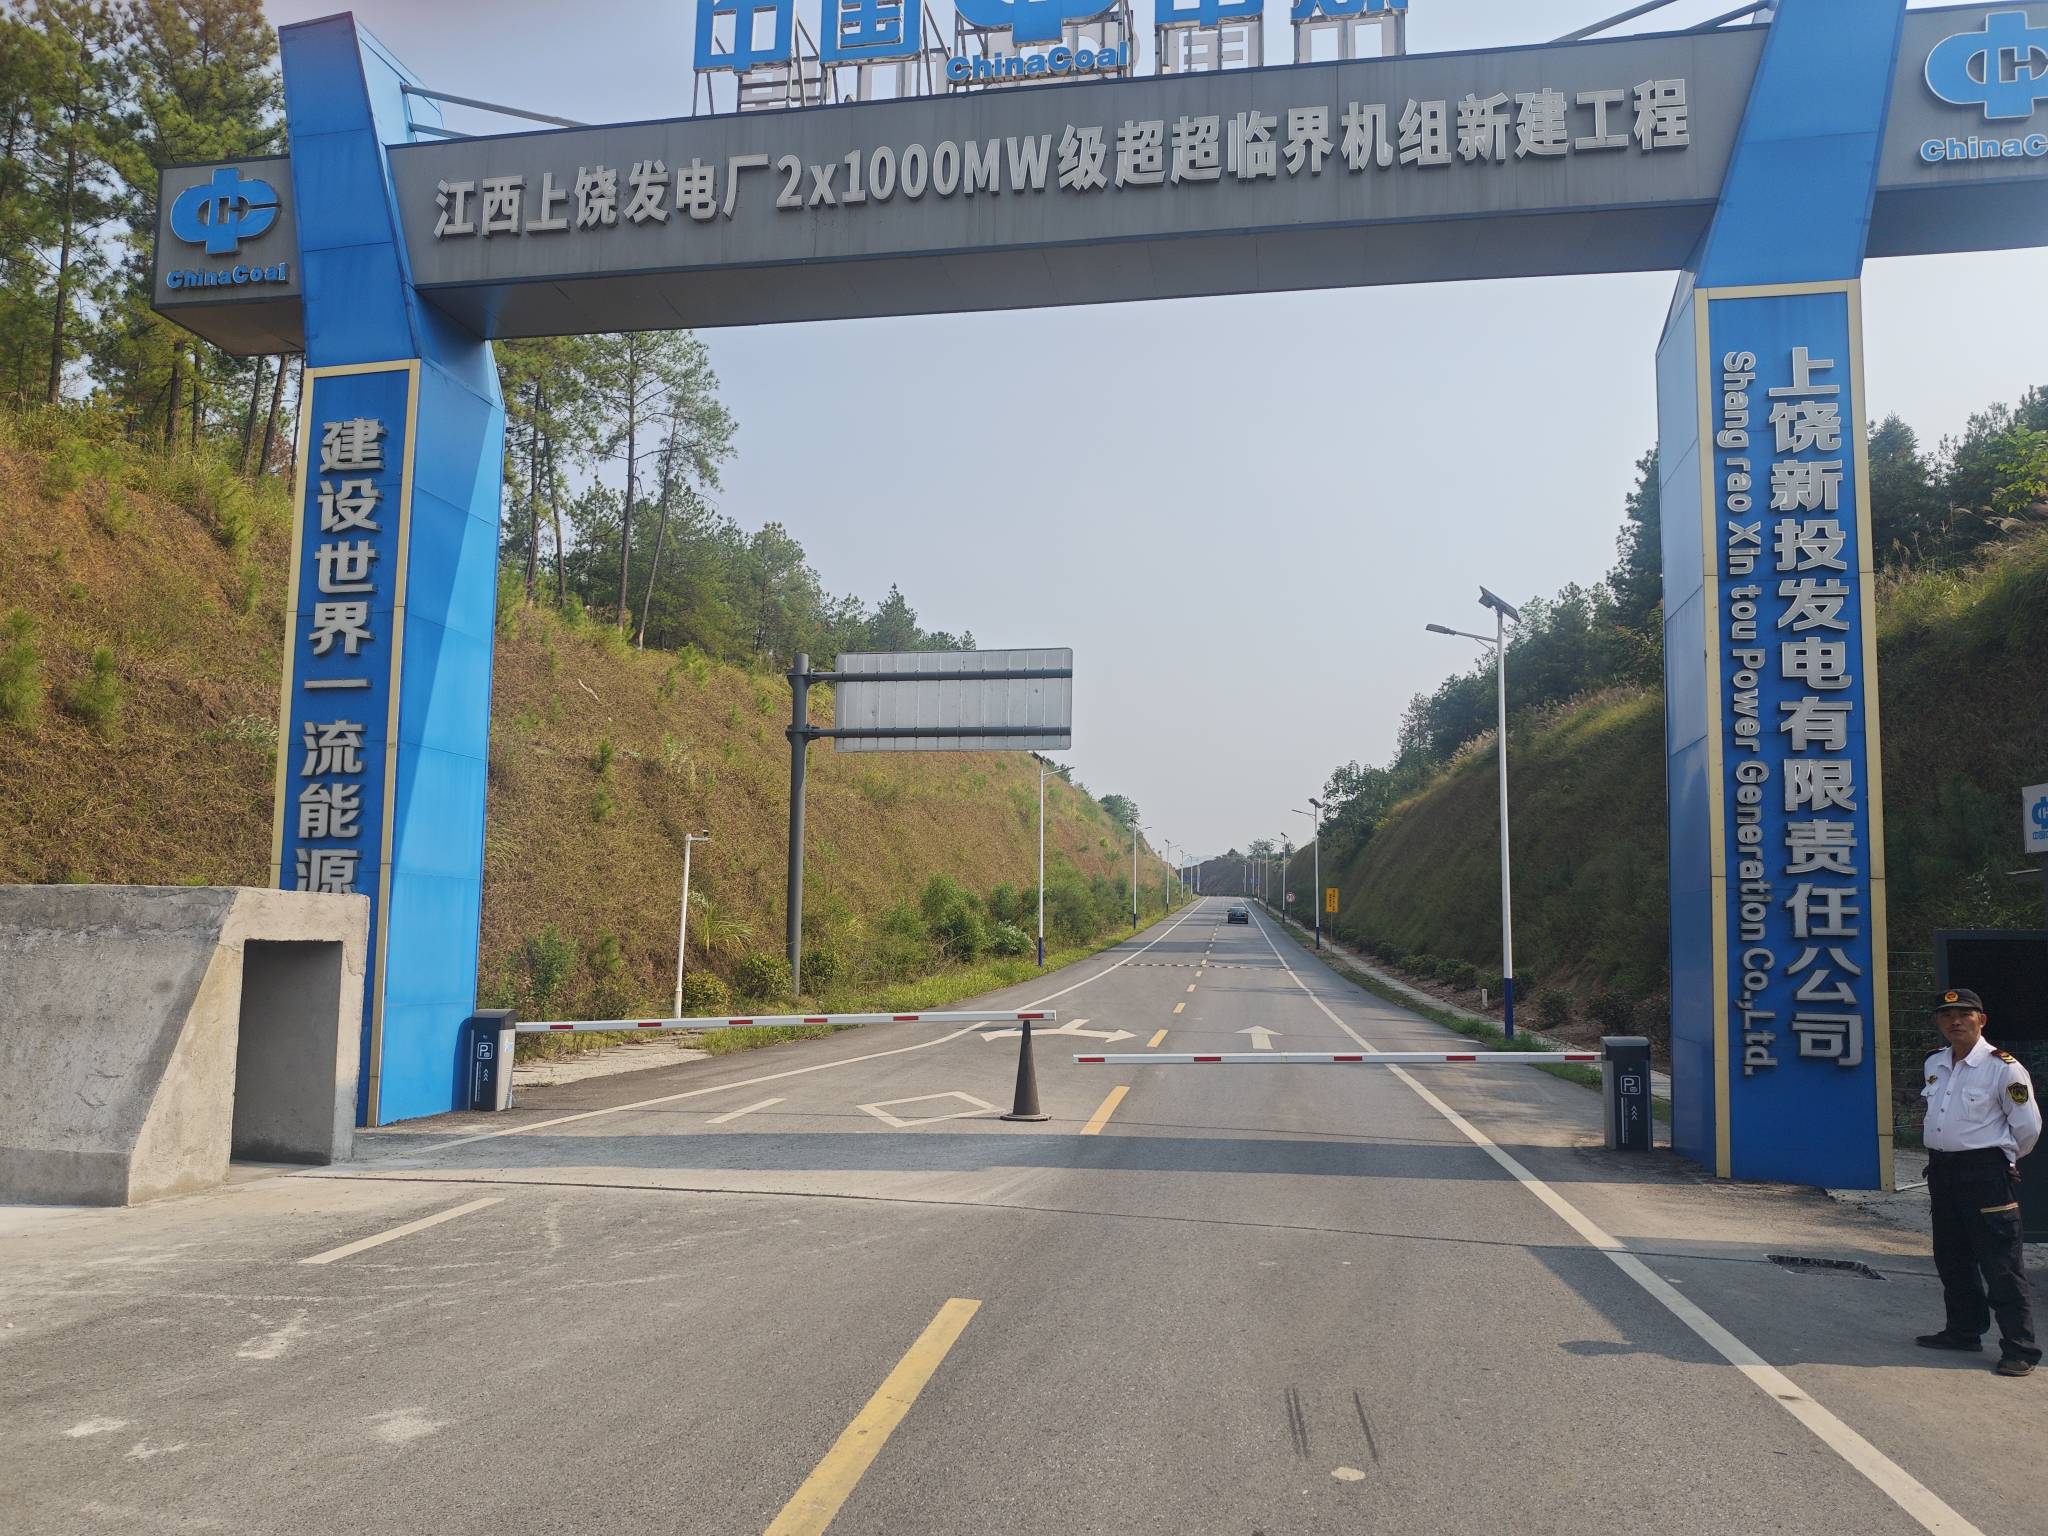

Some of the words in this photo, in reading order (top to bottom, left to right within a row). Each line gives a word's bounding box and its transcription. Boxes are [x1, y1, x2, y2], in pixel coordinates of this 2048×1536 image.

[946, 40, 1129, 82] ChinaCoal
[166, 262, 288, 290] ChinaCoal
[1717, 351, 1756, 449] Shang
[1726, 457, 1752, 512] rao
[1728, 521, 1761, 576] Xin
[1731, 585, 1762, 640] tou
[295, 416, 387, 894] 建设世界一流能源
[1732, 648, 1766, 752] Power
[1768, 346, 1864, 1066] 上饶新投发电有限责任公司
[1735, 760, 1772, 941] Generation
